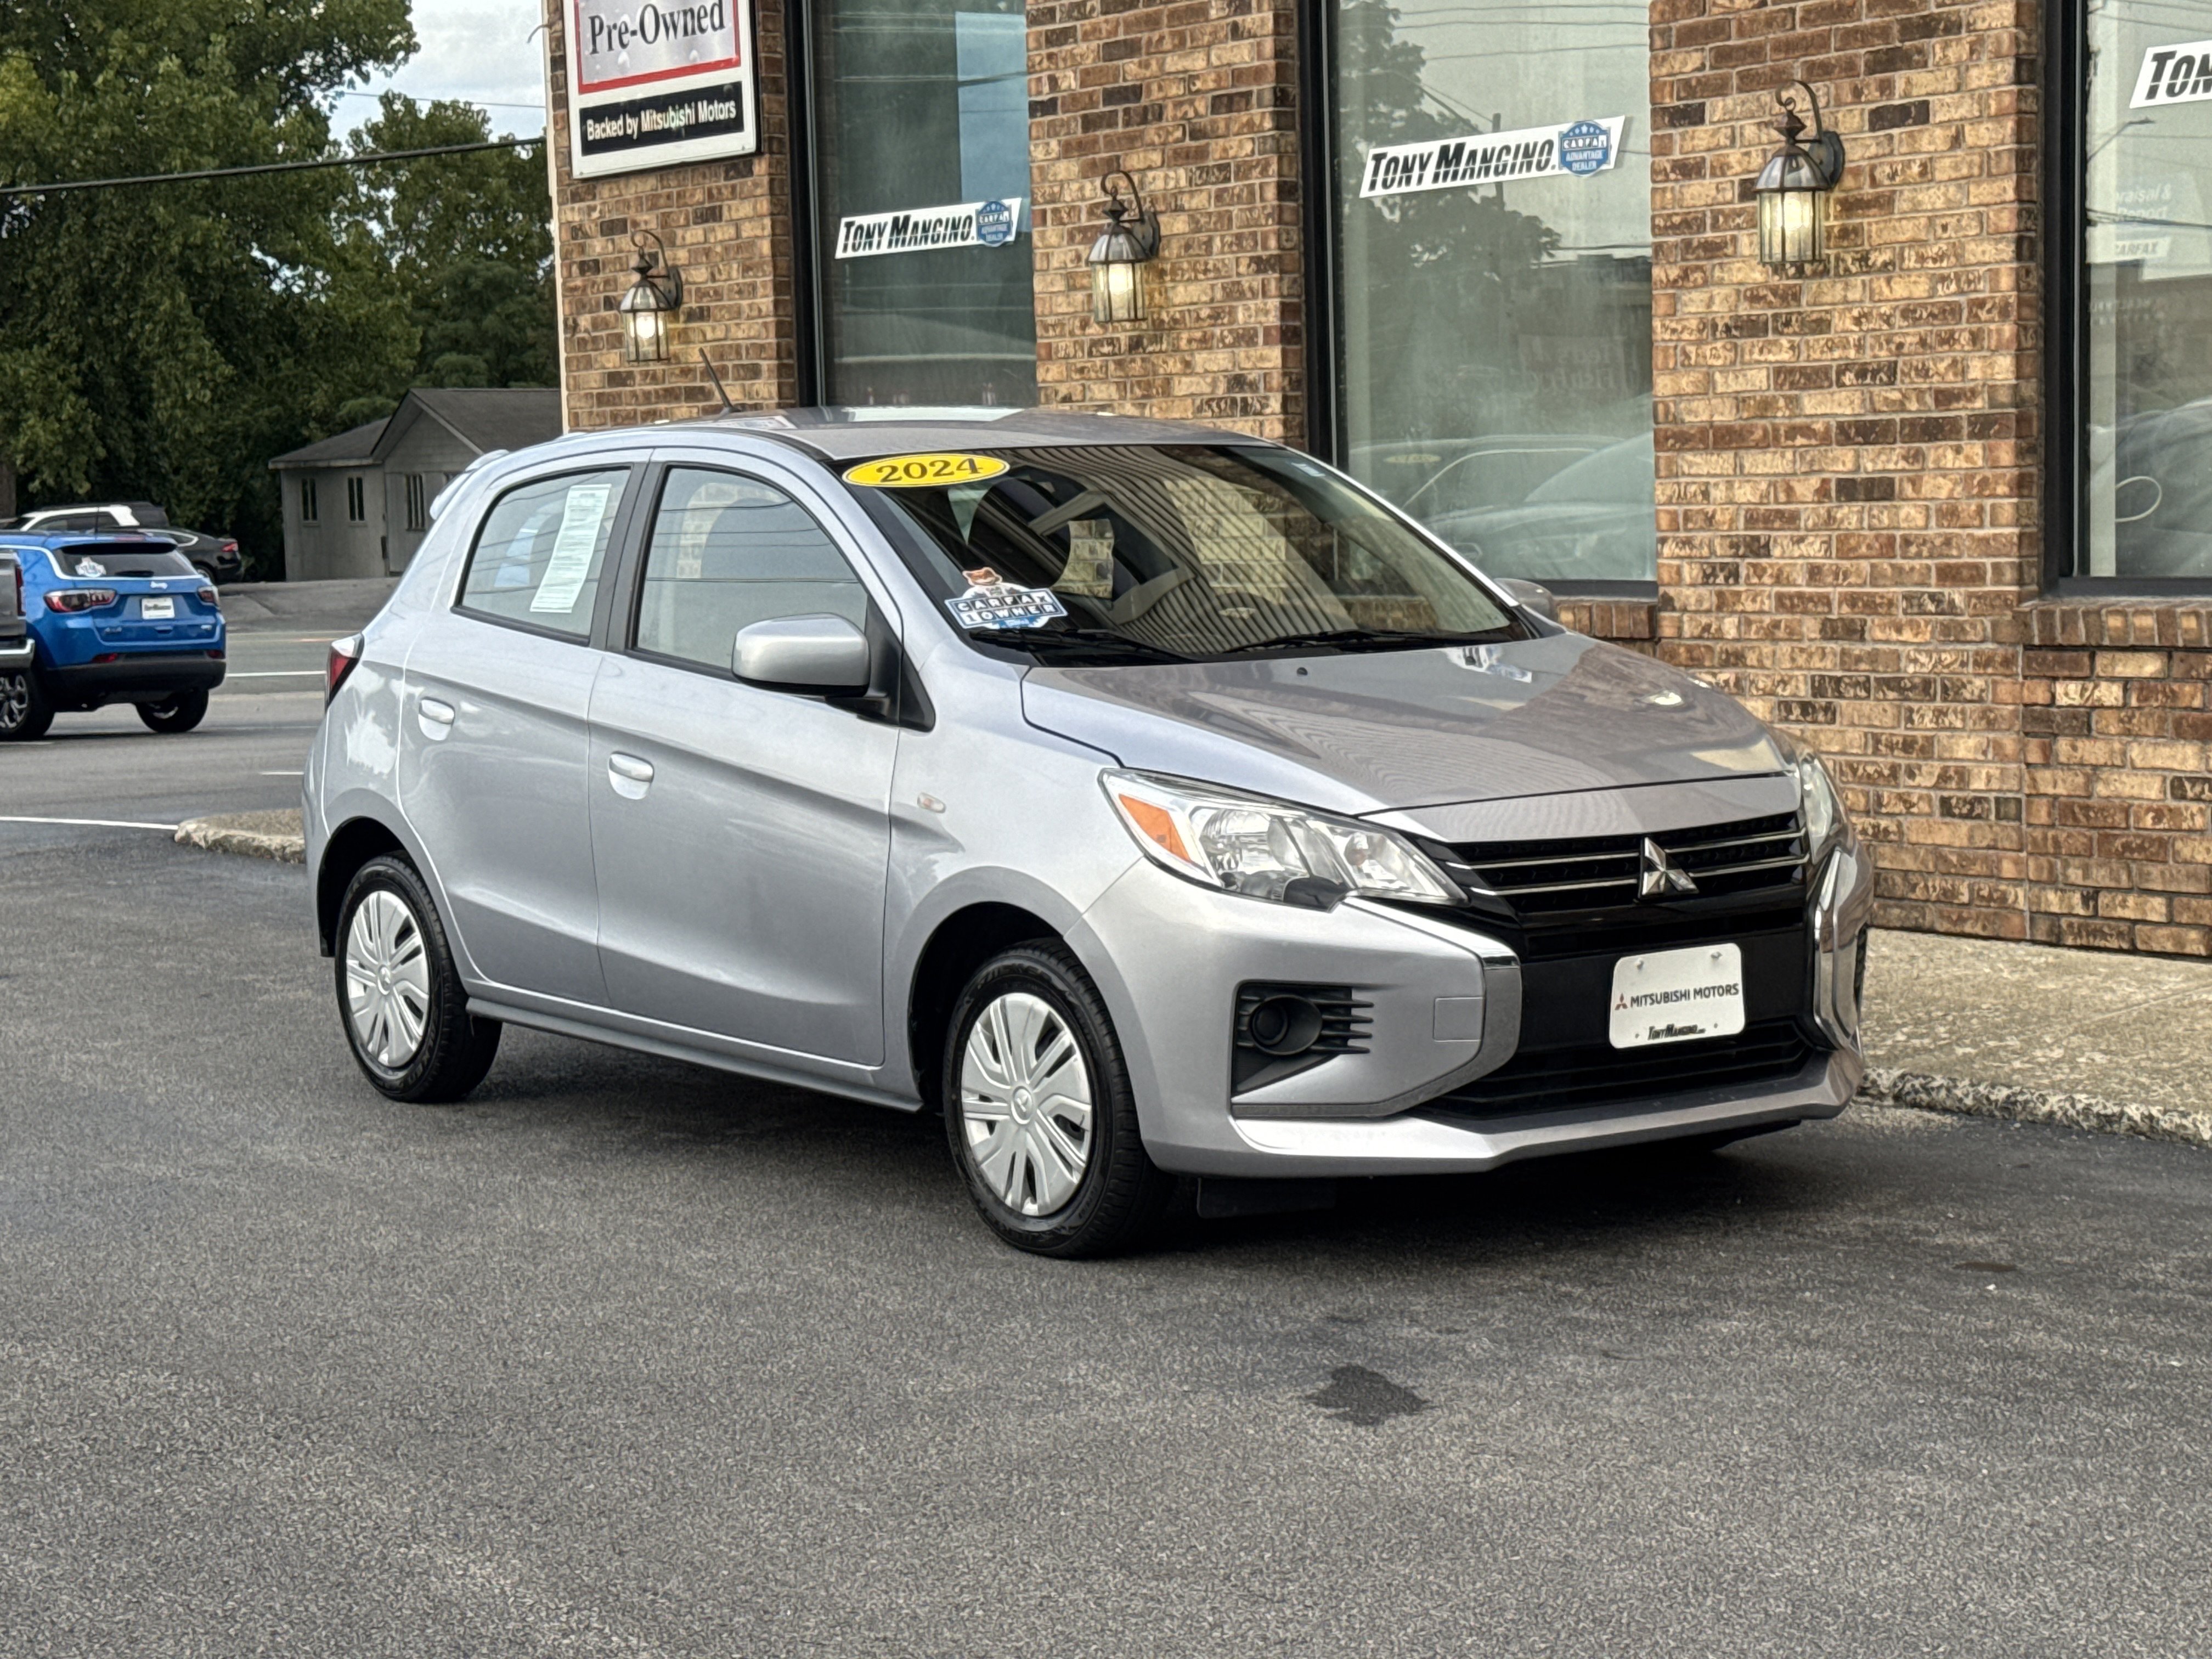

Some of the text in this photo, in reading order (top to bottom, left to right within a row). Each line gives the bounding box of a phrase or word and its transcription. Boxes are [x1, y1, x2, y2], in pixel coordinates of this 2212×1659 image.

[588, 0, 725, 55] Pre-Owned
[586, 99, 736, 141] Backed by Mitsubishi Motors
[1566, 149, 1605, 162] ADVANTAGE
[1572, 160, 1597, 172] DEALER
[1368, 151, 1433, 192] TONY
[842, 220, 888, 253] TONY
[876, 458, 983, 482] 2024
[958, 595, 1049, 611] CARFAX
[966, 604, 1056, 622] 1 OWNER
[1630, 983, 1739, 1007] MITSUBISHI MOTORS
